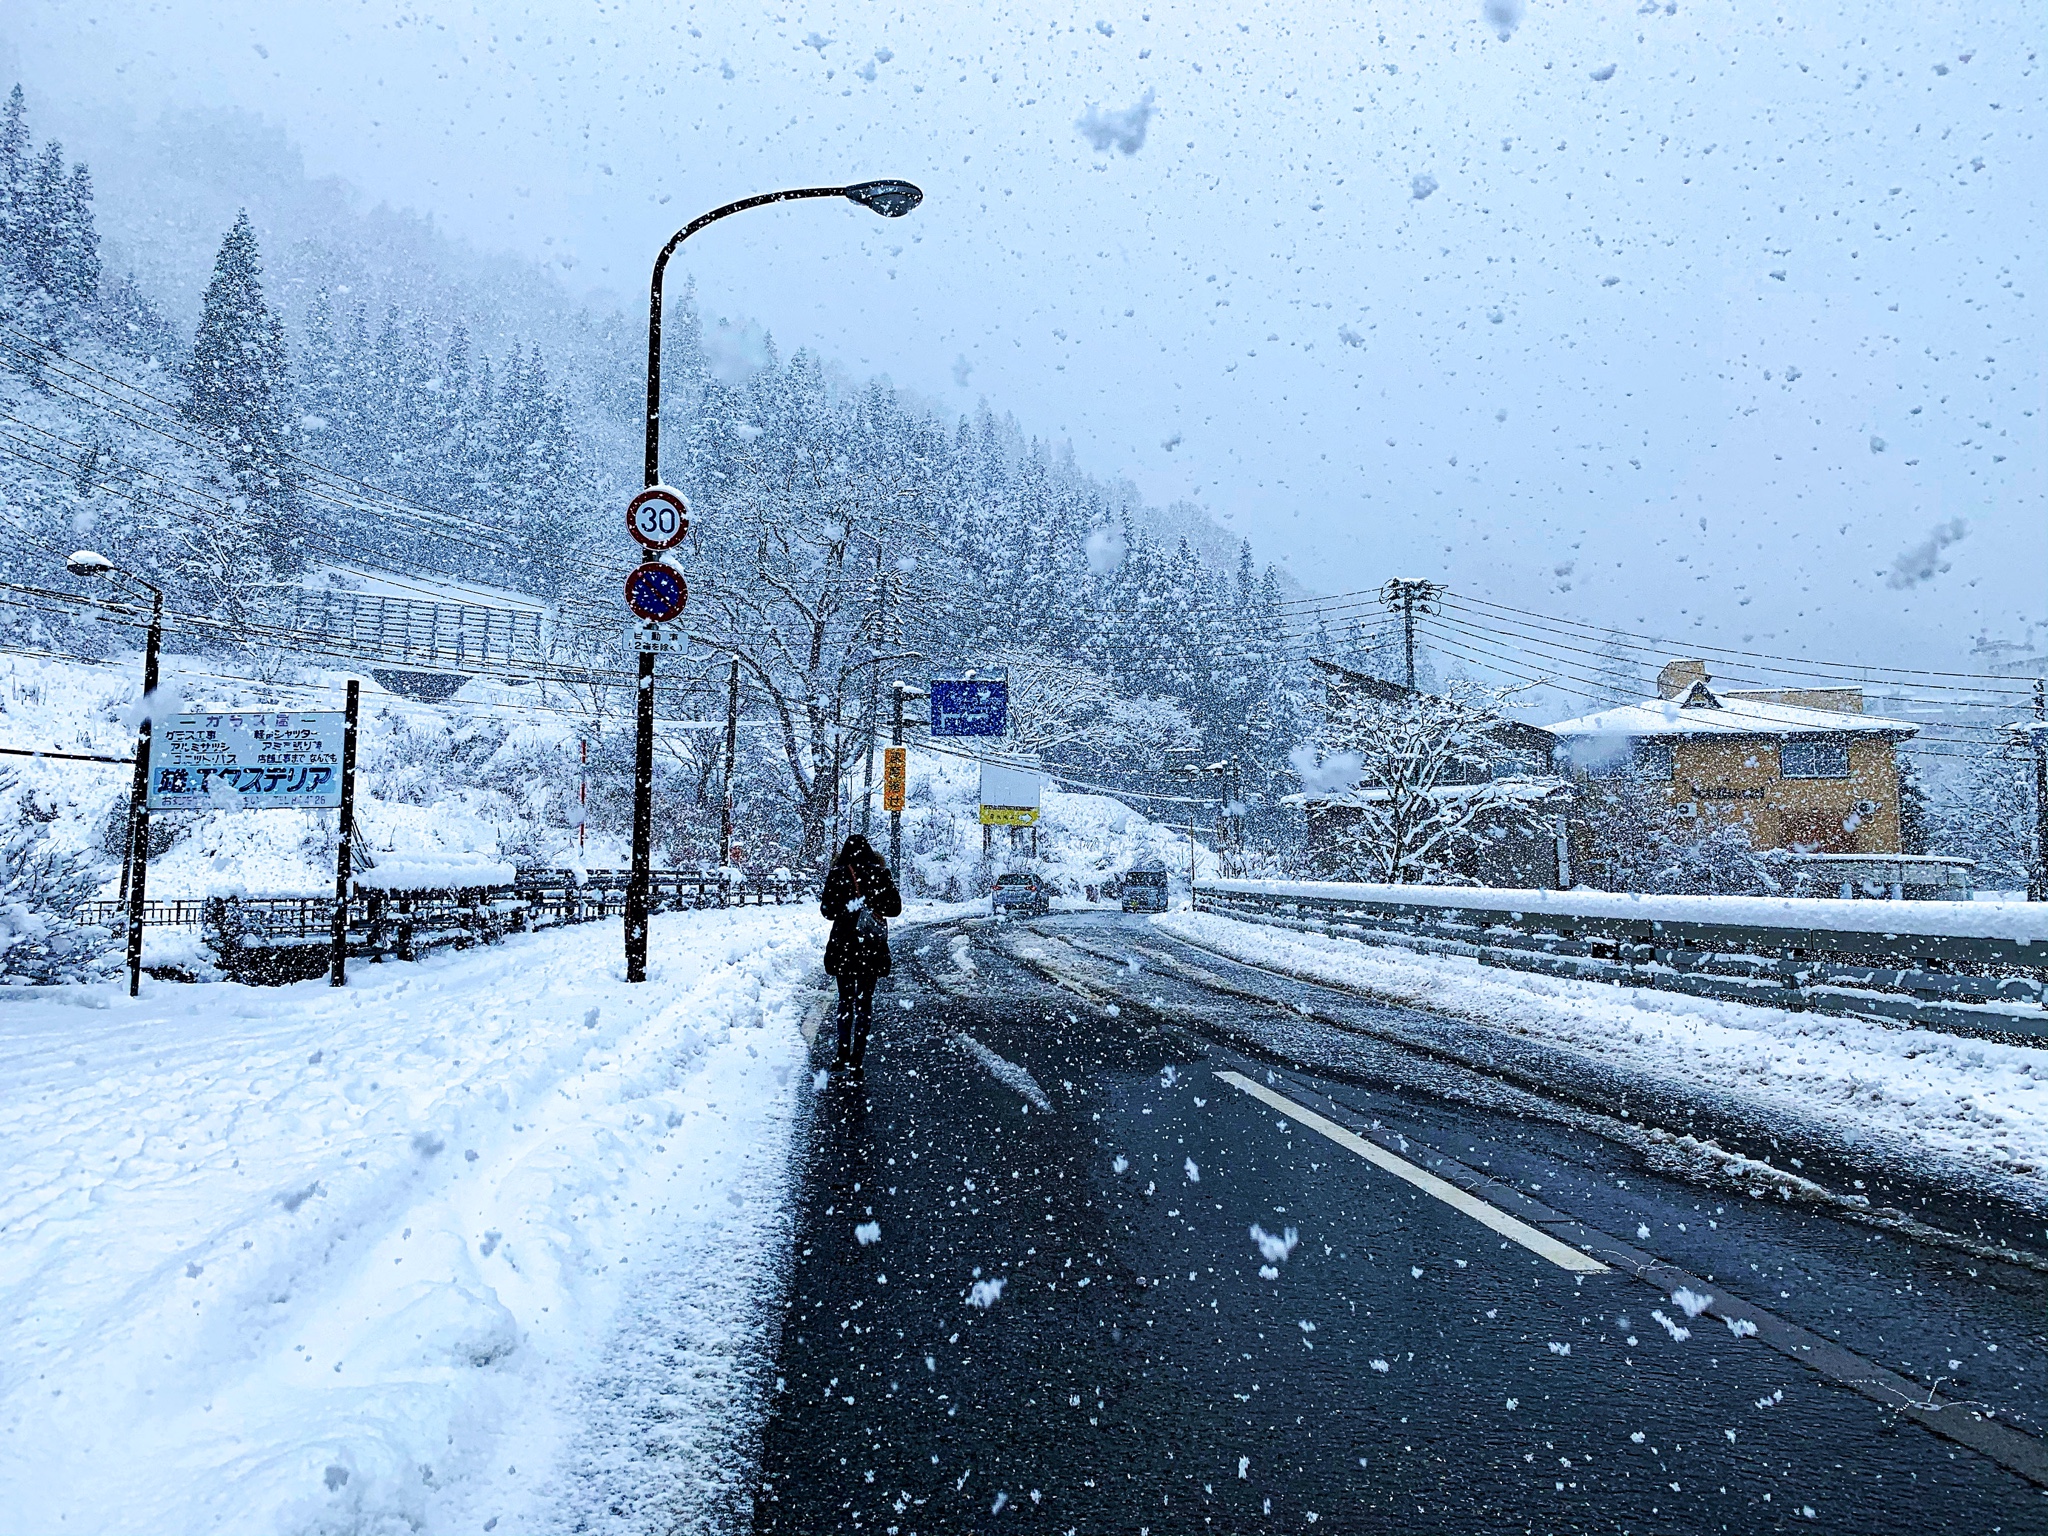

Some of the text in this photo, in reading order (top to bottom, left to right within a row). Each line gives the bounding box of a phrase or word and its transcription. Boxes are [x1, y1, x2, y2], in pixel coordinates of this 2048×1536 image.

[641, 506, 676, 534] 30
[633, 631, 679, 642] 自動車
[170, 742, 231, 753] アルミサッシ
